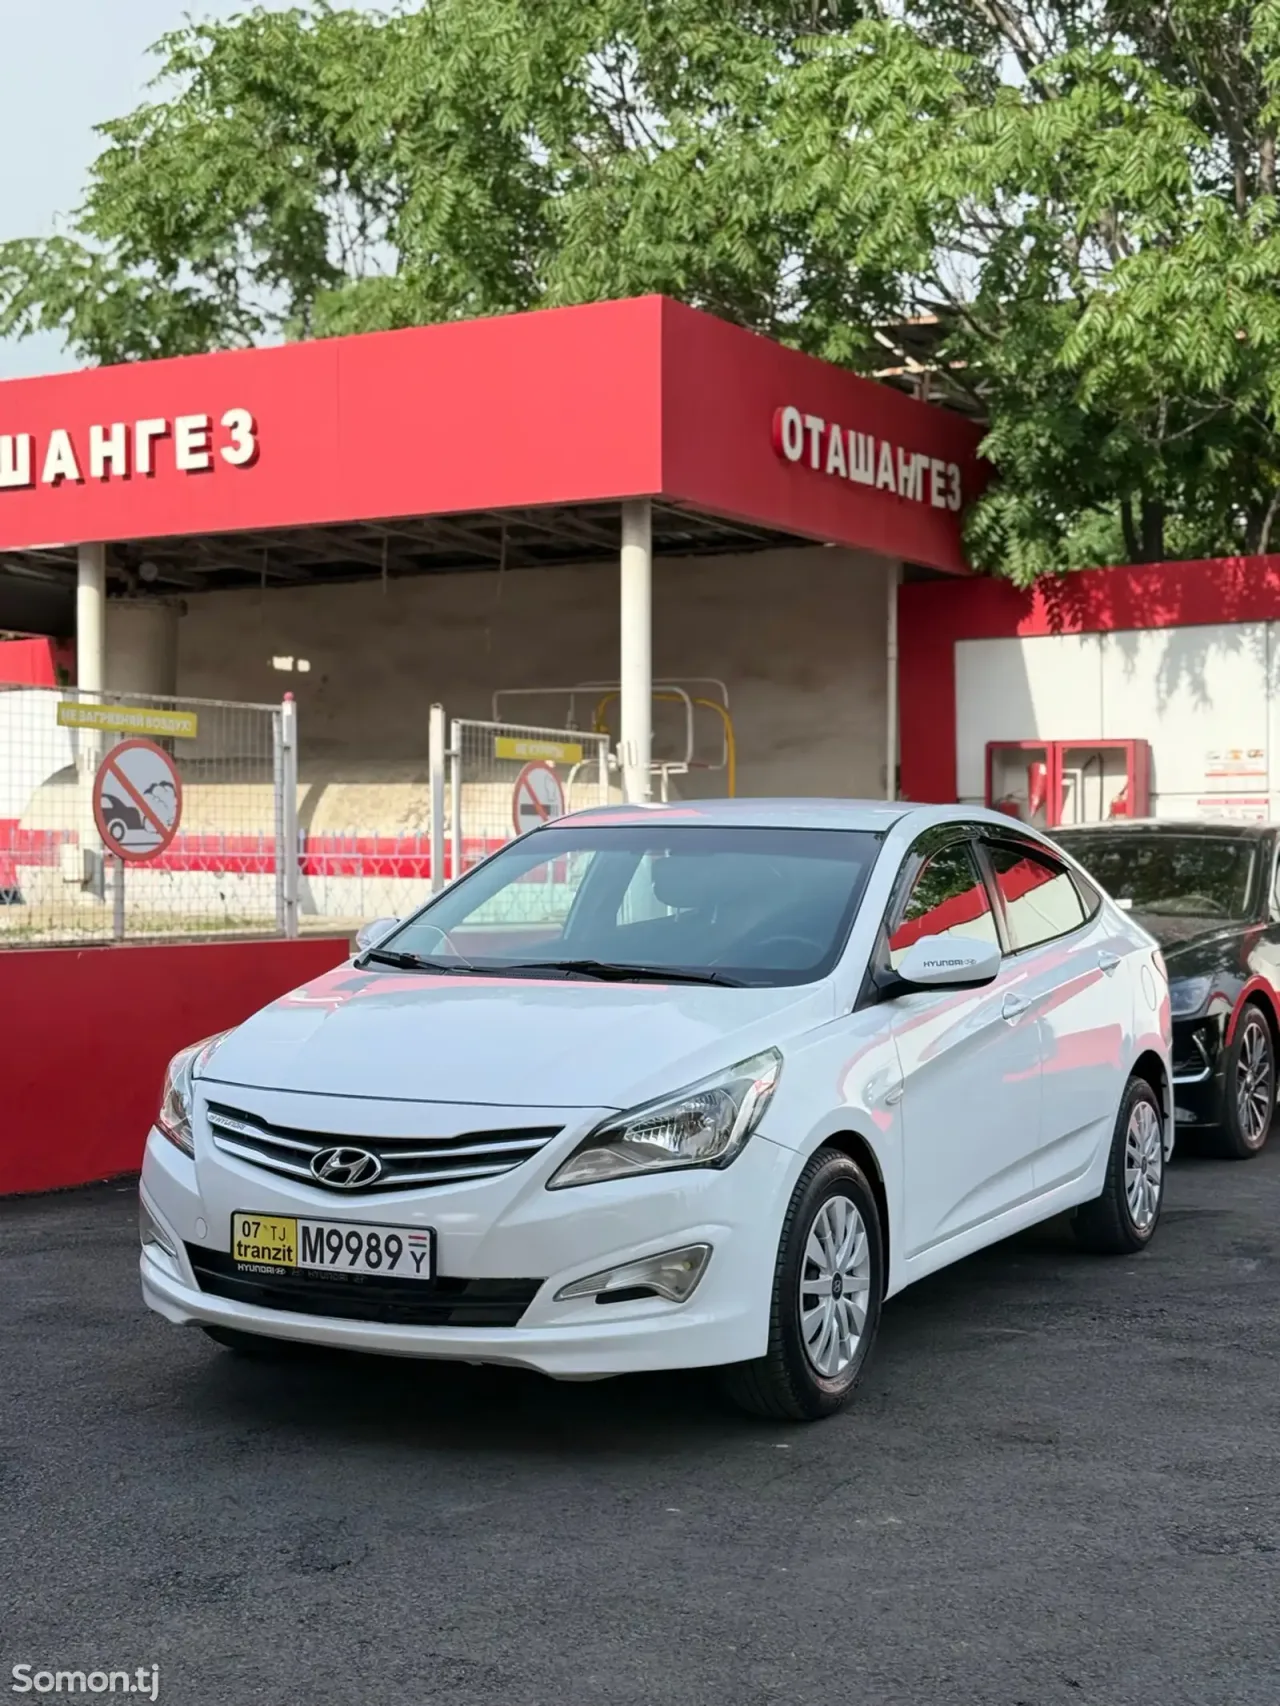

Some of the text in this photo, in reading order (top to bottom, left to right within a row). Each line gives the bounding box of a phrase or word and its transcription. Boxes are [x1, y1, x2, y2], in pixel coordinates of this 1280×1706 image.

[779, 405, 962, 512] ОТАШАНГЕЗ
[923, 959, 964, 968] HYUNDAI
[242, 1220, 287, 1241] 07 TJ
[236, 1240, 294, 1262] tranzit
[301, 1225, 403, 1271] M9989
[410, 1251, 427, 1274] Y
[237, 1263, 275, 1275] HYUNDAI
